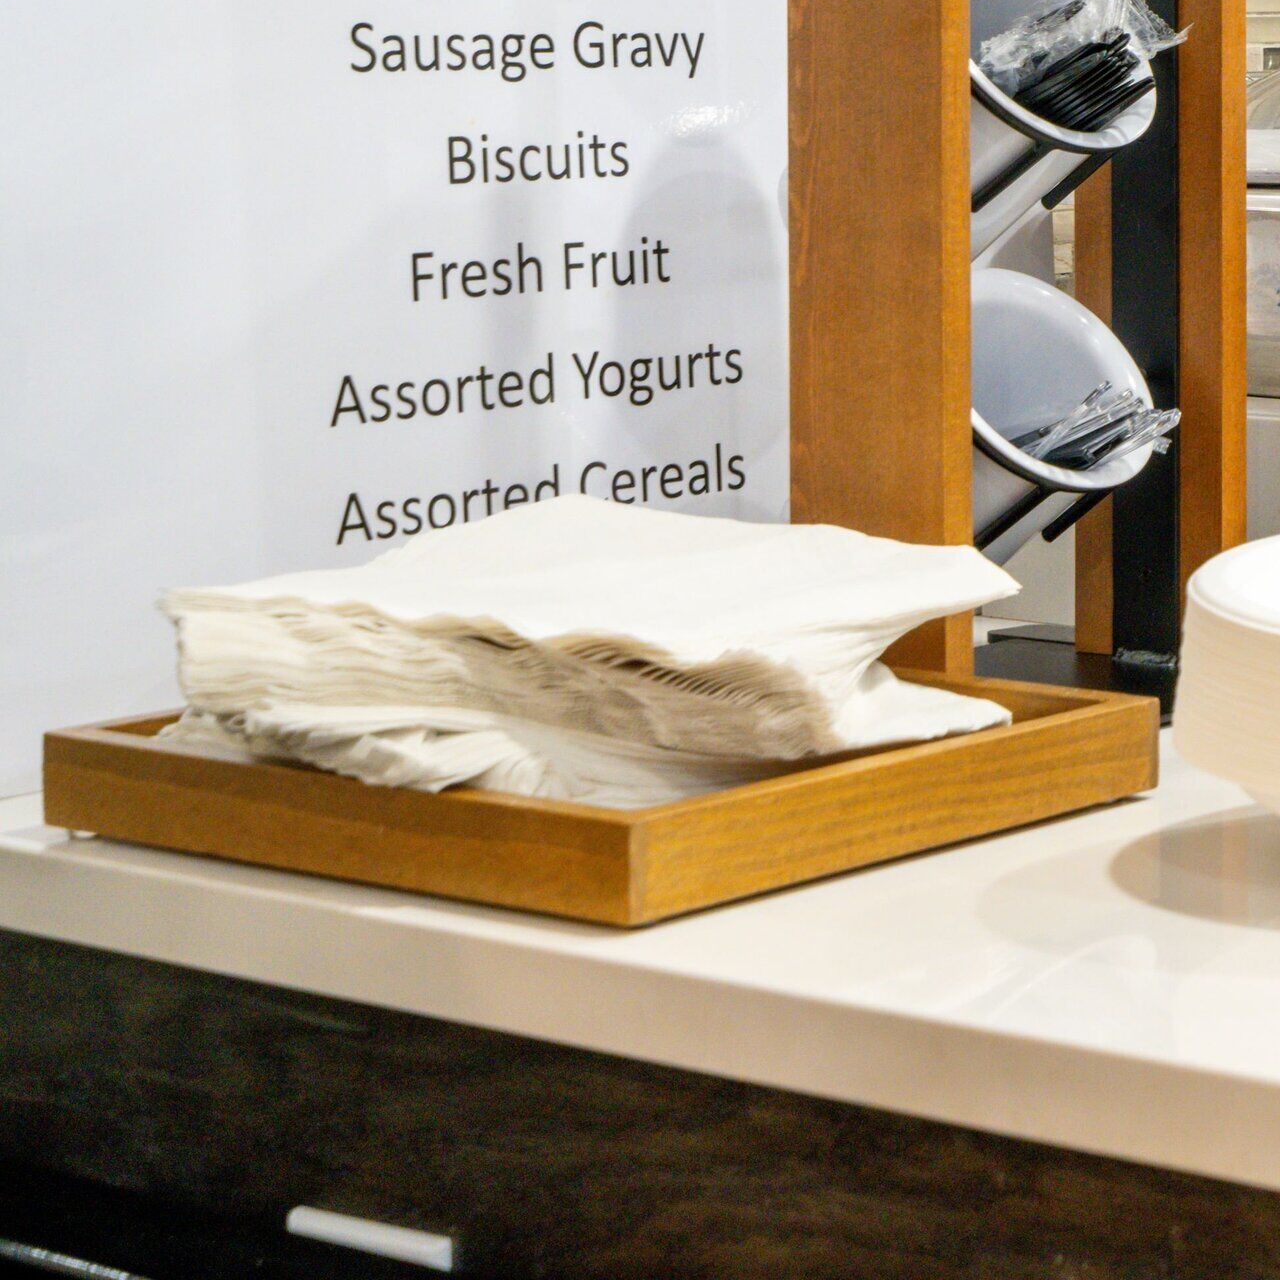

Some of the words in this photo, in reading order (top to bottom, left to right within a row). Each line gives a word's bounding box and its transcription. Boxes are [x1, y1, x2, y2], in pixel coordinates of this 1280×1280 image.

[350, 21, 555, 82] Sausage
[573, 21, 705, 79] Gravy
[447, 131, 630, 185] Biscuits
[411, 242, 543, 302] Fresh
[563, 237, 671, 291] Fruit
[330, 353, 555, 427] Assorted
[572, 343, 744, 410] Yogurts
[336, 464, 560, 546] Assorted
[580, 442, 746, 504] Cereals
